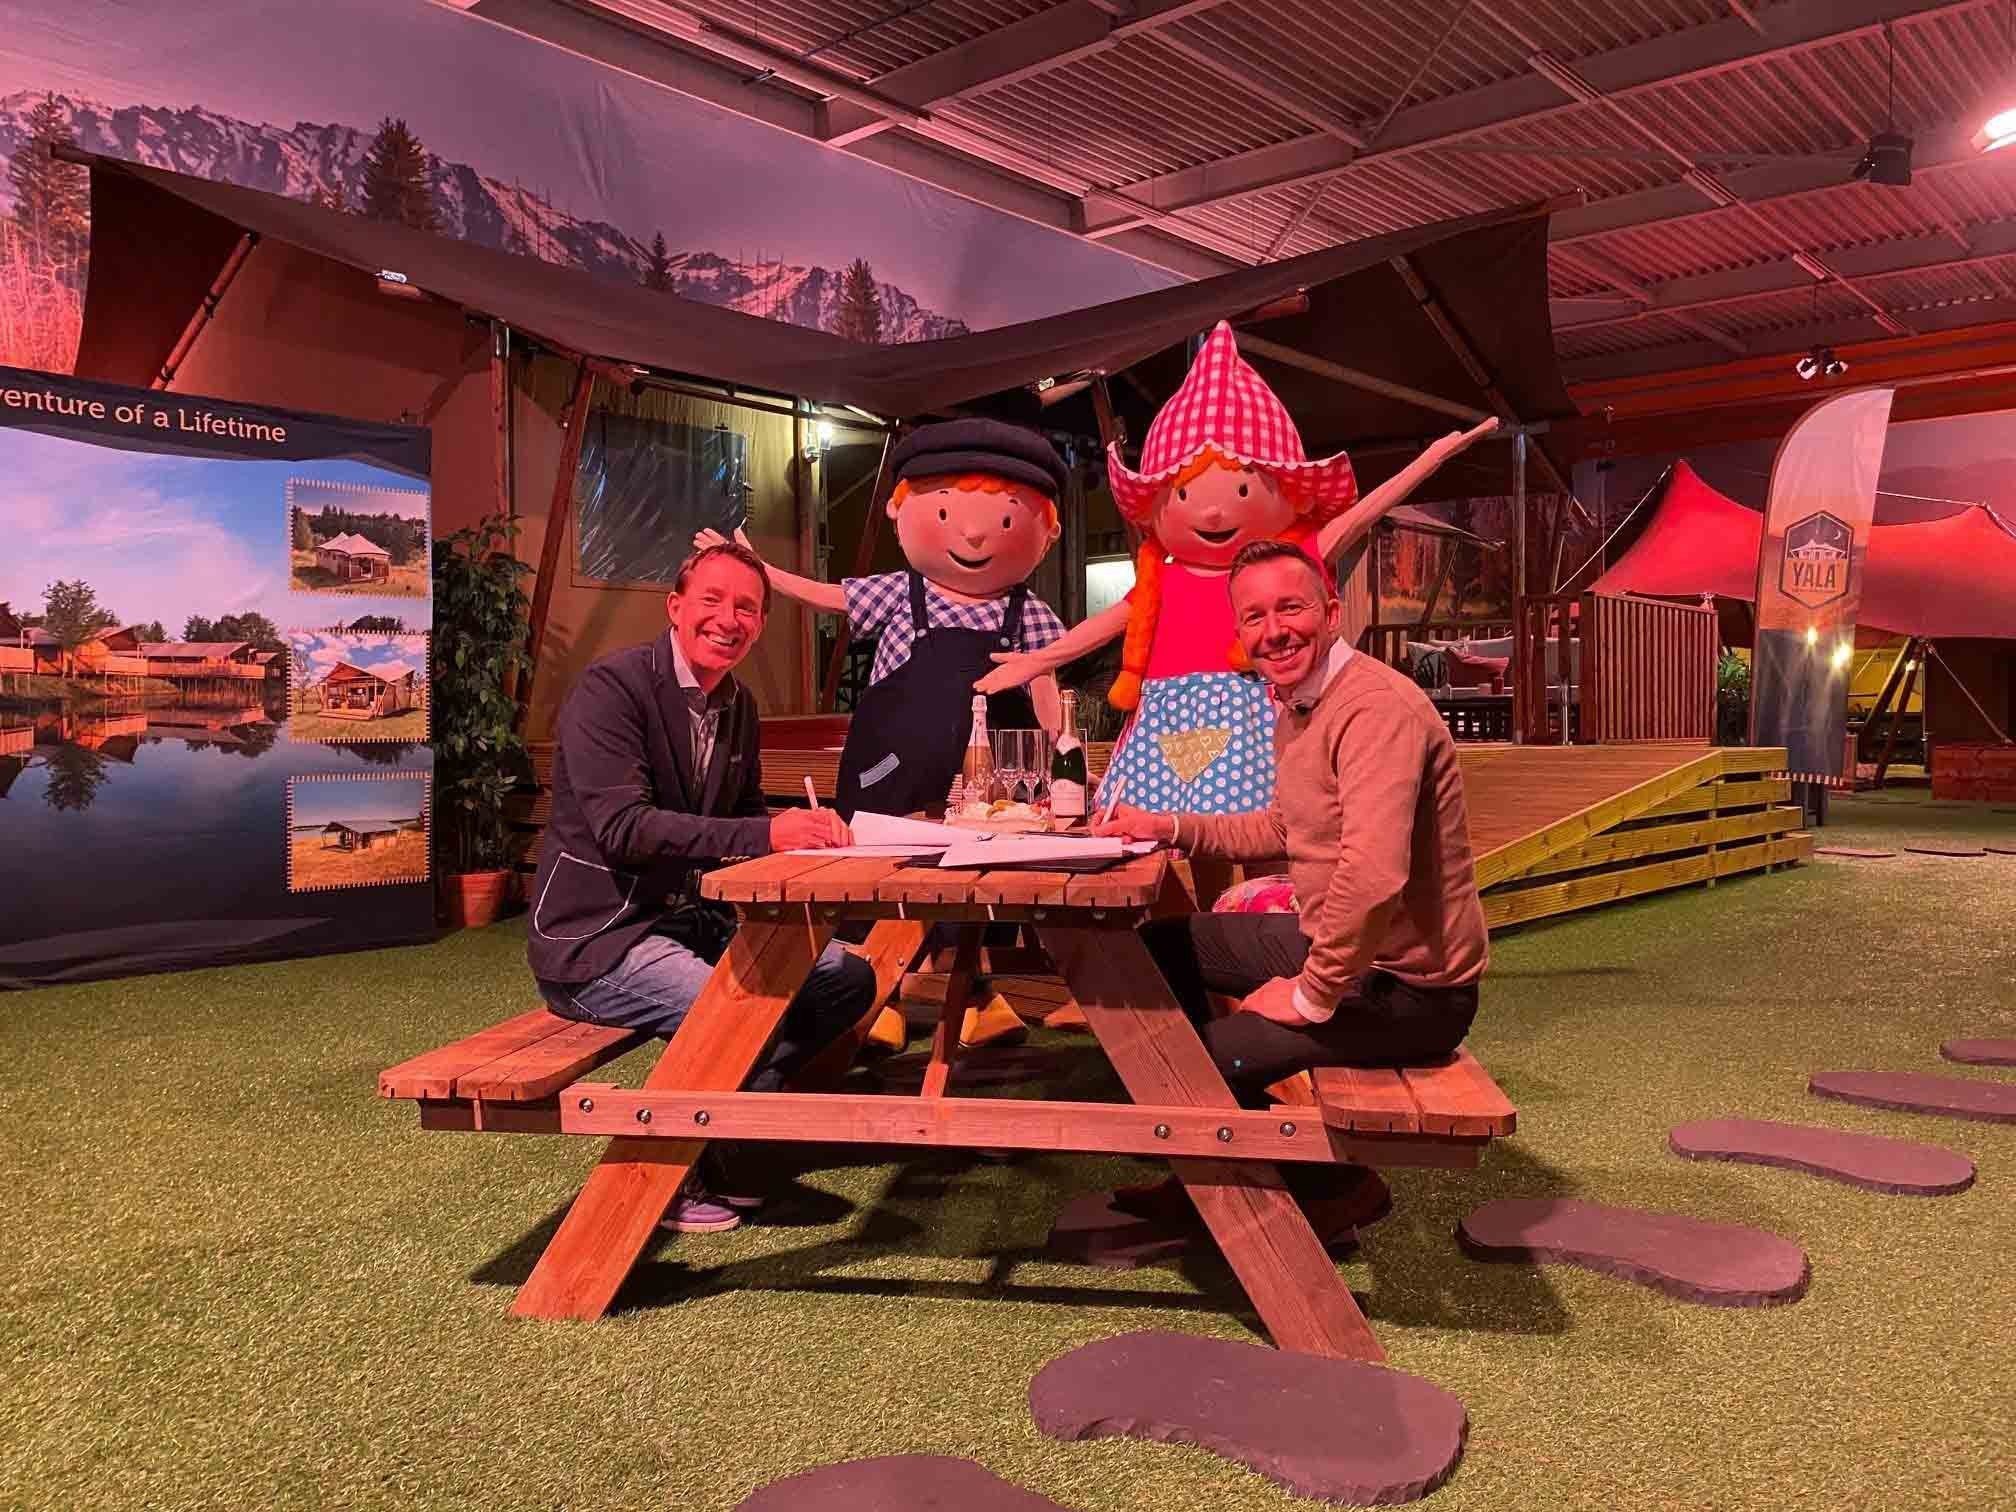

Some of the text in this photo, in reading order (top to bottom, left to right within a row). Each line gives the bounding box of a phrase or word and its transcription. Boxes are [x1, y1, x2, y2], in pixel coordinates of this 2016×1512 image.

[115, 403, 145, 425] of
[153, 410, 170, 428] a
[179, 409, 286, 443] Lifetime
[1792, 562, 1836, 588] YALA
